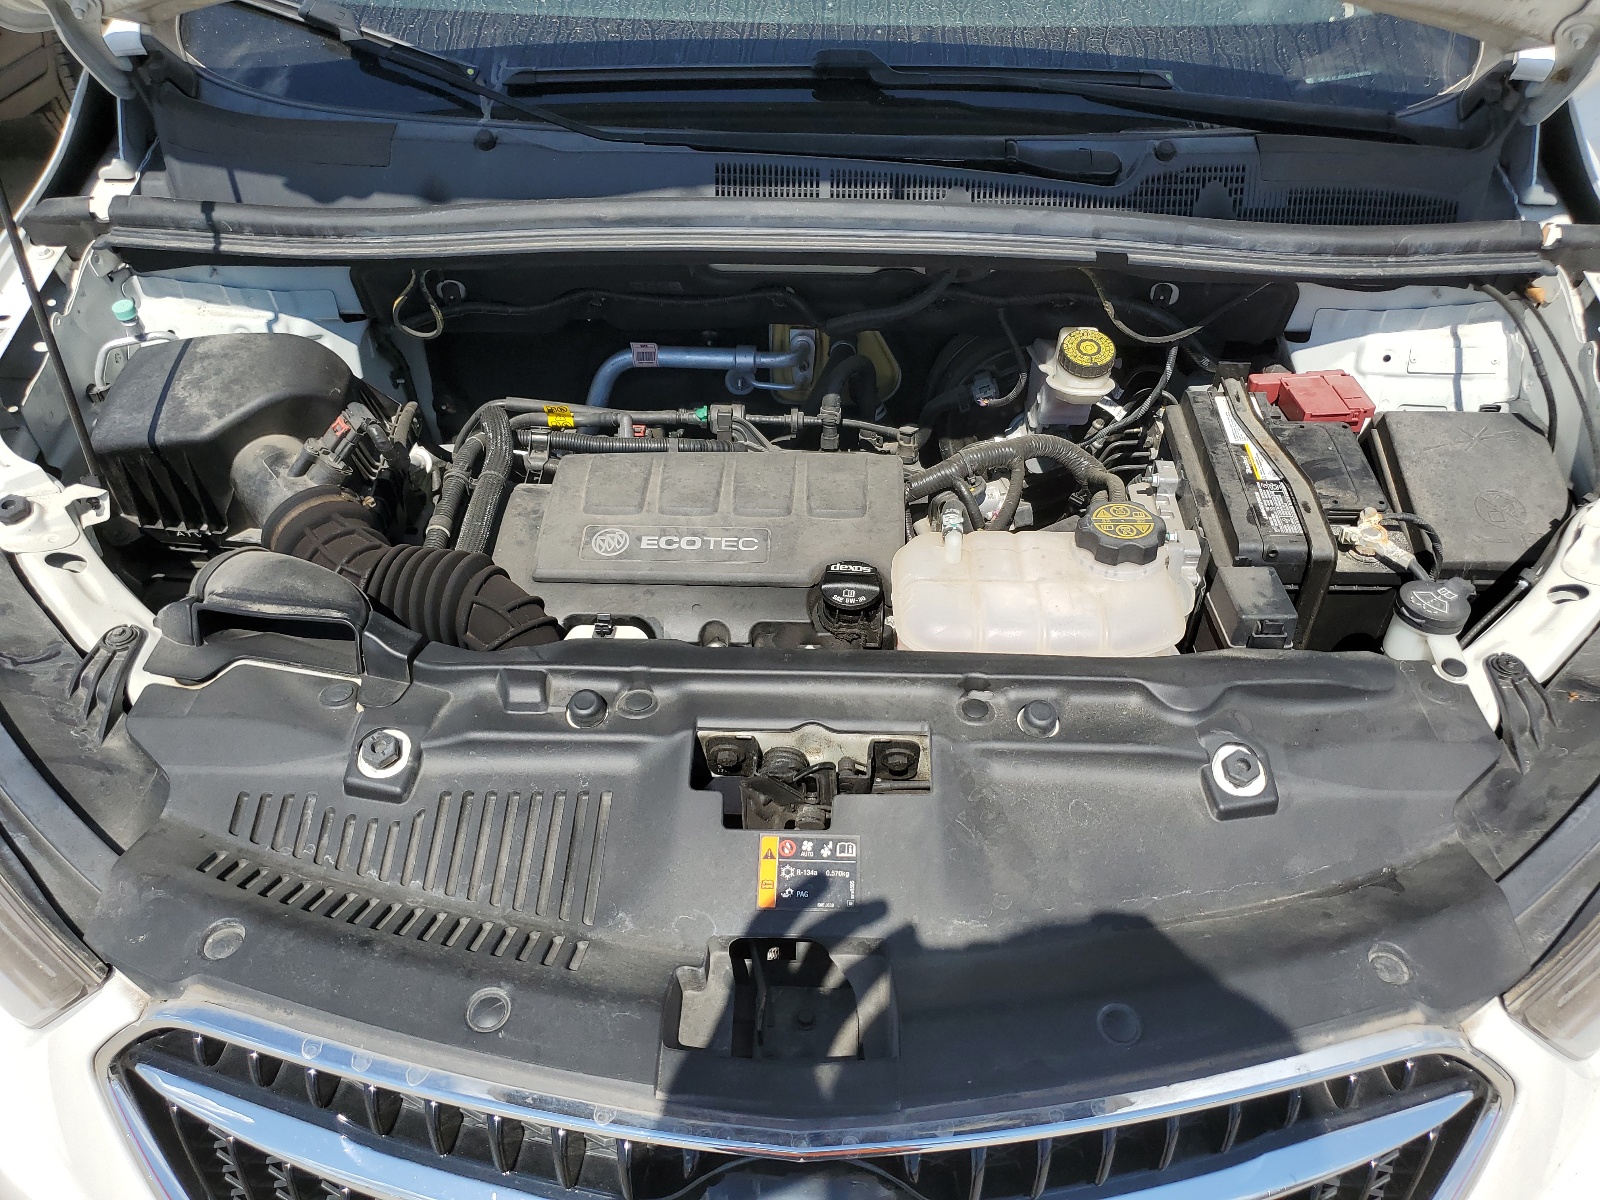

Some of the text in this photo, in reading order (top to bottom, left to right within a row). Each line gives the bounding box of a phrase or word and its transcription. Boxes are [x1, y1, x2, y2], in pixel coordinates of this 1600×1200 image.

[640, 536, 759, 551] ECOTEC
[830, 563, 871, 573] dexos
[825, 870, 850, 878] 0.570kg
[796, 890, 809, 898] PAG
